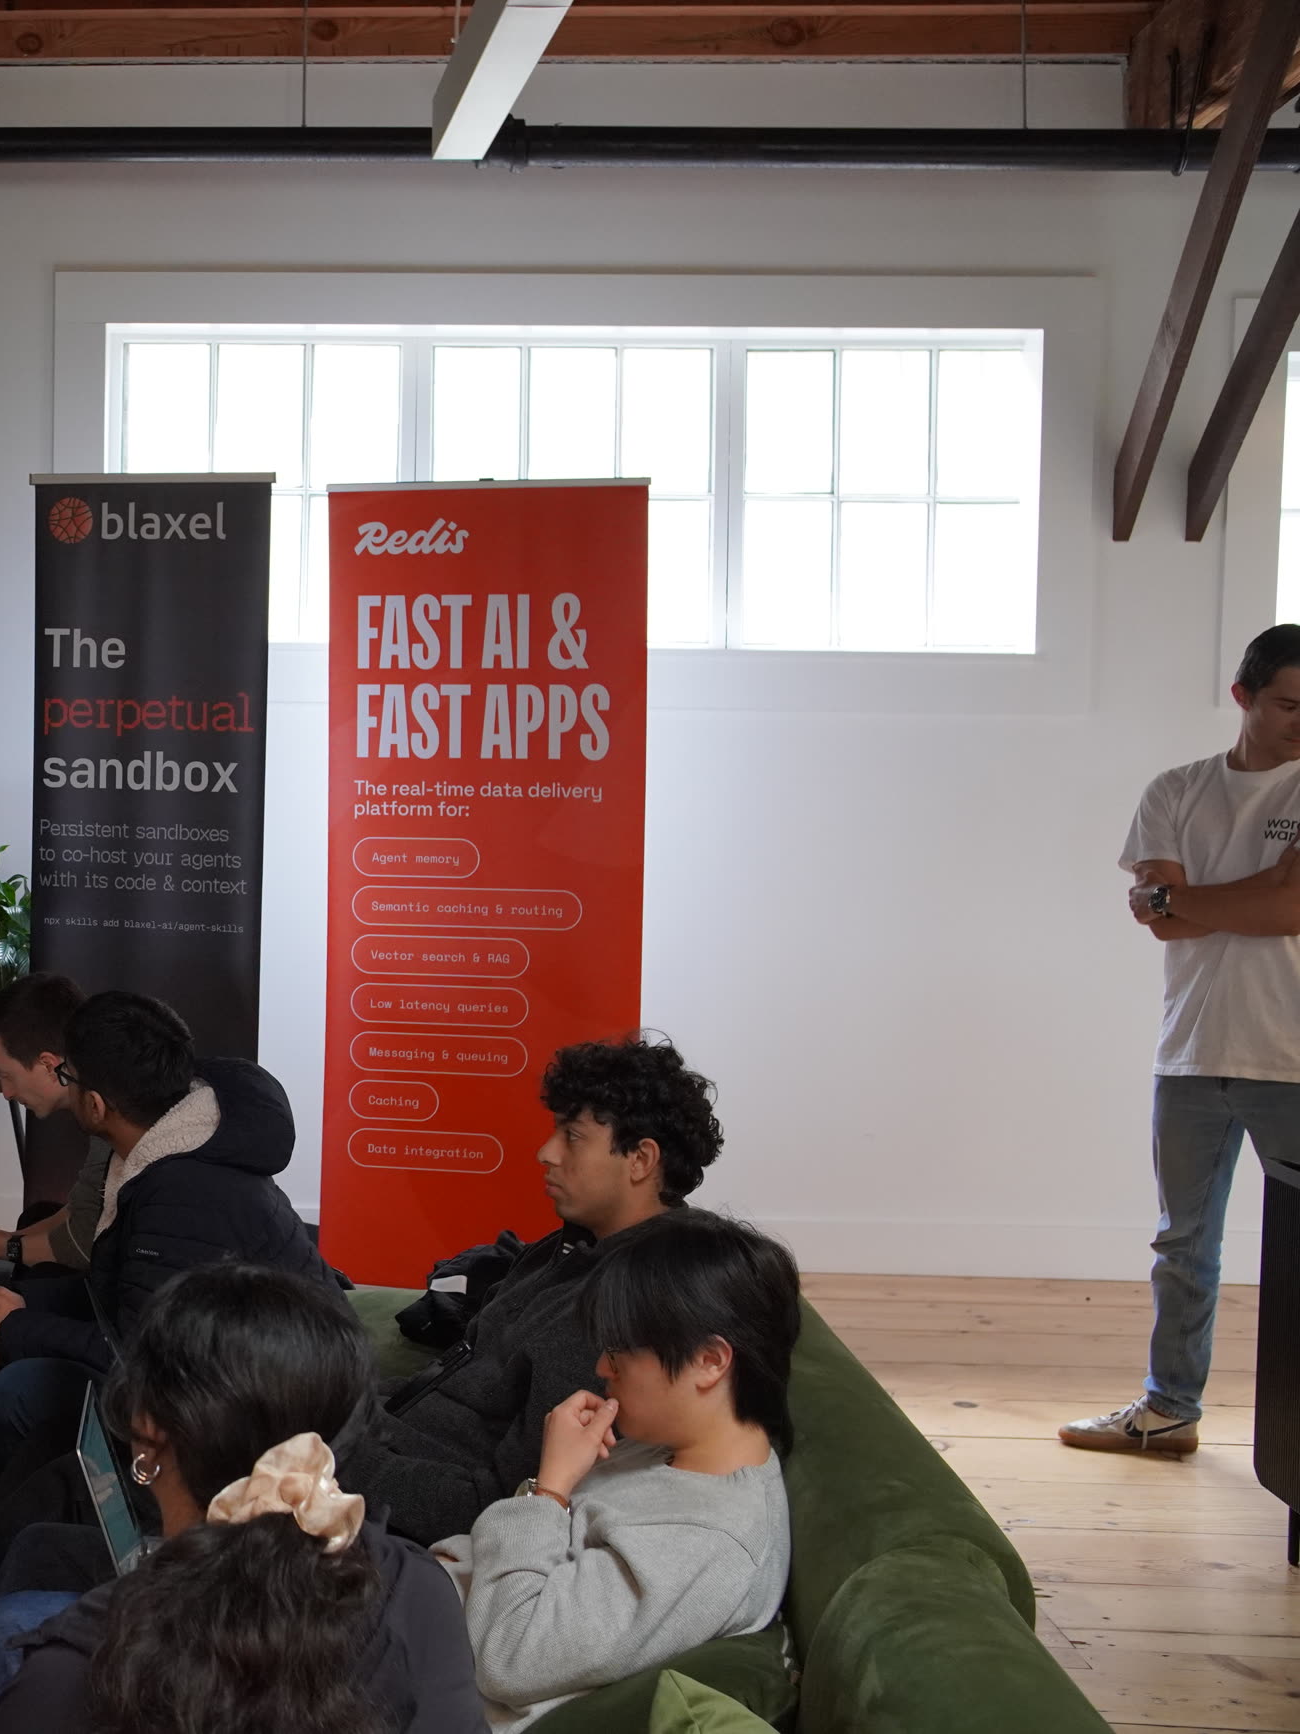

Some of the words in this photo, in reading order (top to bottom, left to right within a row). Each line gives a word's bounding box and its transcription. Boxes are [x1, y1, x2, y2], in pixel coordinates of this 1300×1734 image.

[100, 501, 226, 541] blaxel
[354, 518, 470, 556] Redis
[356, 594, 472, 670] FAST
[481, 594, 530, 670] AI
[548, 592, 590, 670] &
[44, 628, 126, 668] The
[43, 693, 254, 736] perpetual
[356, 683, 472, 760] FAST
[480, 683, 610, 761] APPS
[42, 750, 238, 792] sandbox
[354, 780, 387, 796] The
[392, 781, 475, 798] real-time
[480, 782, 523, 798] data
[528, 782, 603, 802] delivery
[354, 800, 432, 820] platform
[438, 801, 470, 817] for:
[40, 819, 129, 838] Persistent
[135, 823, 230, 842] sandboxes
[1268, 818, 1300, 830] wor
[1264, 830, 1296, 842] war
[40, 847, 56, 862] to
[62, 846, 128, 865] co-host
[134, 851, 172, 868] your
[180, 852, 242, 873] agents
[372, 852, 408, 866] Agent
[416, 854, 460, 866] memory
[40, 872, 78, 888] with
[84, 873, 108, 890] its
[114, 875, 156, 892] code
[163, 877, 175, 892] &
[181, 879, 248, 896] context
[371, 900, 430, 913] Semantic
[436, 903, 488, 916] caching
[496, 904, 503, 914] &
[510, 904, 563, 918] routing
[44, 916, 60, 926] npx
[65, 916, 98, 928] skills
[102, 917, 120, 928] add
[124, 920, 244, 934] blaxel-ai/agent-skills
[370, 950, 414, 962] Vector
[422, 952, 466, 963] search
[473, 953, 480, 963] &
[487, 954, 510, 964] RAG
[370, 998, 392, 1009] Low
[400, 1000, 450, 1014] latency
[457, 1002, 508, 1014] queries
[369, 1047, 434, 1061] Messaging
[442, 1050, 449, 1059] &
[456, 1050, 508, 1064] queuing
[368, 1095, 420, 1109] Caching
[368, 1144, 396, 1155] Data
[404, 1144, 484, 1160] integration
